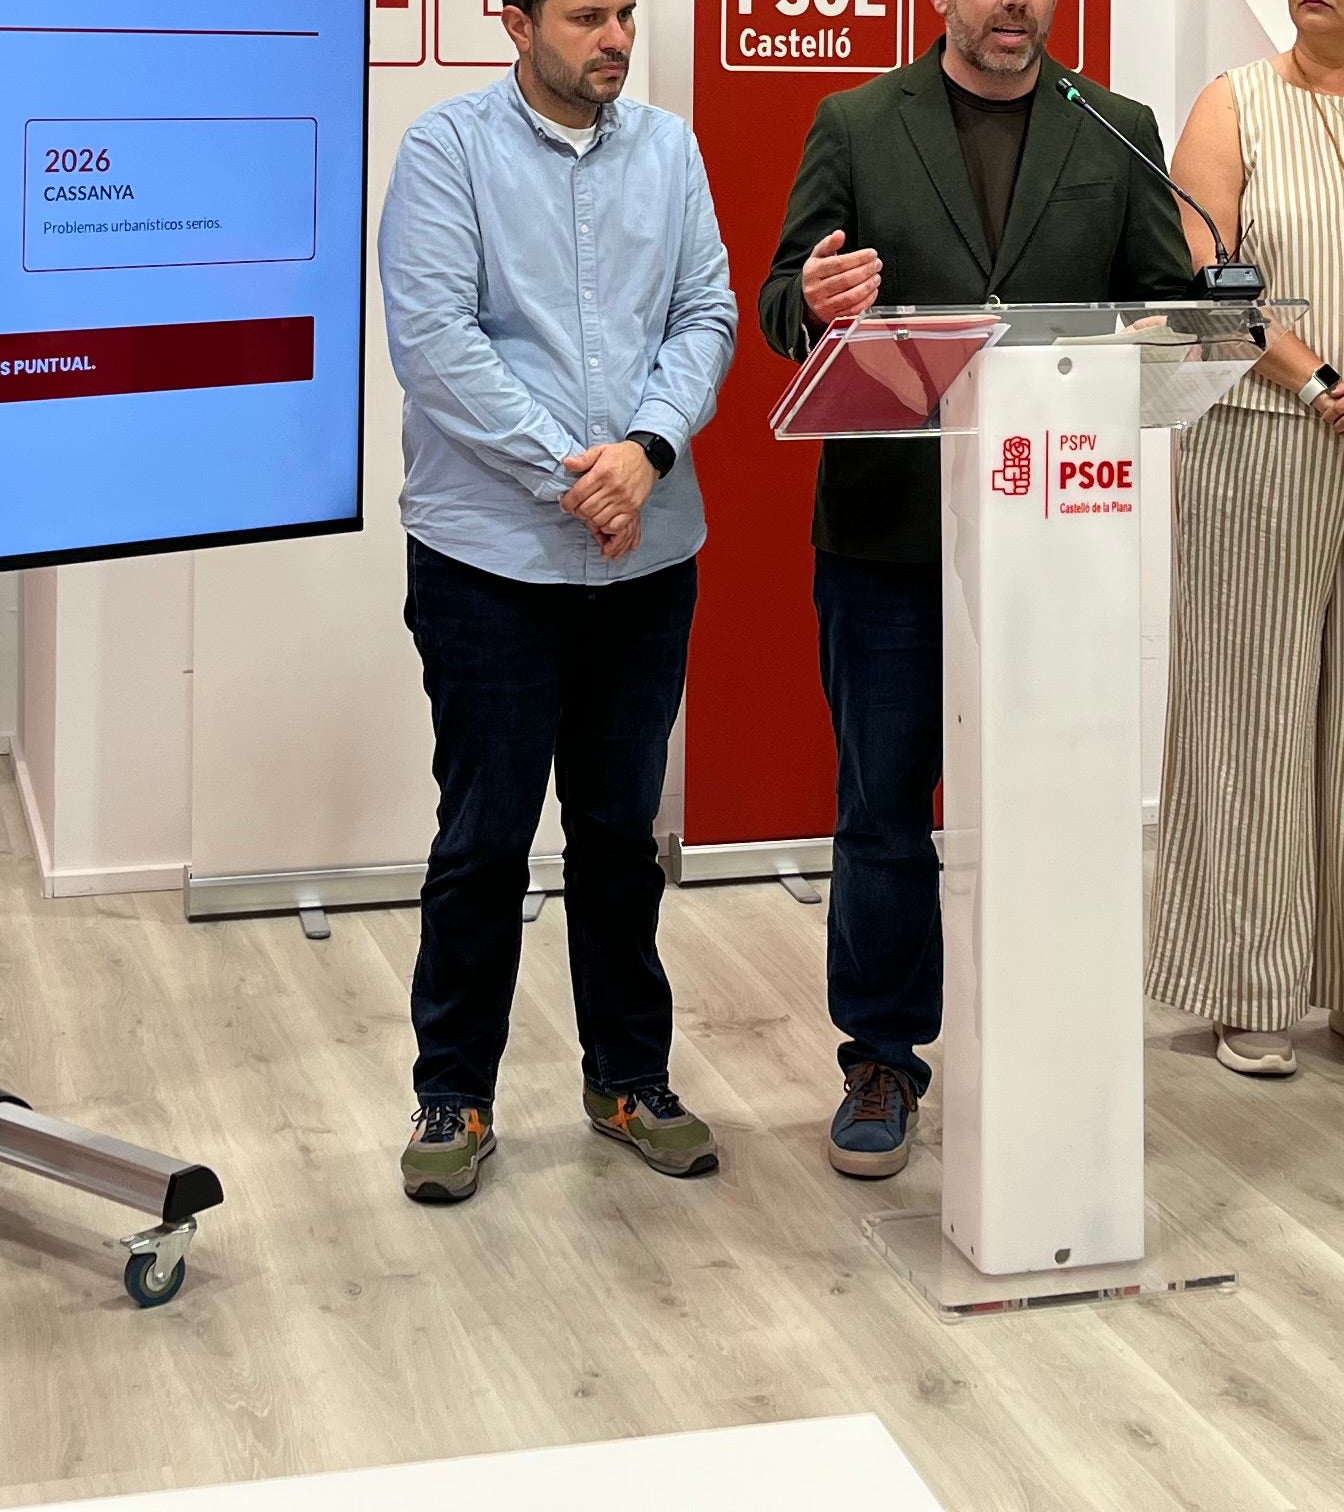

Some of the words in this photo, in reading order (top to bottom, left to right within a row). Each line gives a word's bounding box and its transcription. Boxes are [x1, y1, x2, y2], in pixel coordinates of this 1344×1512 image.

[739, 26, 852, 60] Castelló
[45, 149, 111, 173] 2026
[44, 185, 134, 201] CASSANYA
[44, 221, 108, 234] Problemas
[111, 218, 183, 232] urbanísticos
[186, 218, 222, 230] serios.
[14, 355, 96, 375] PUNTUAL.
[1060, 435, 1097, 450] PSPV
[1060, 461, 1133, 489] PSOE
[1060, 501, 1090, 513] Castelló
[1092, 501, 1101, 513] de
[1103, 501, 1110, 513] la
[1112, 501, 1132, 513] Plana
